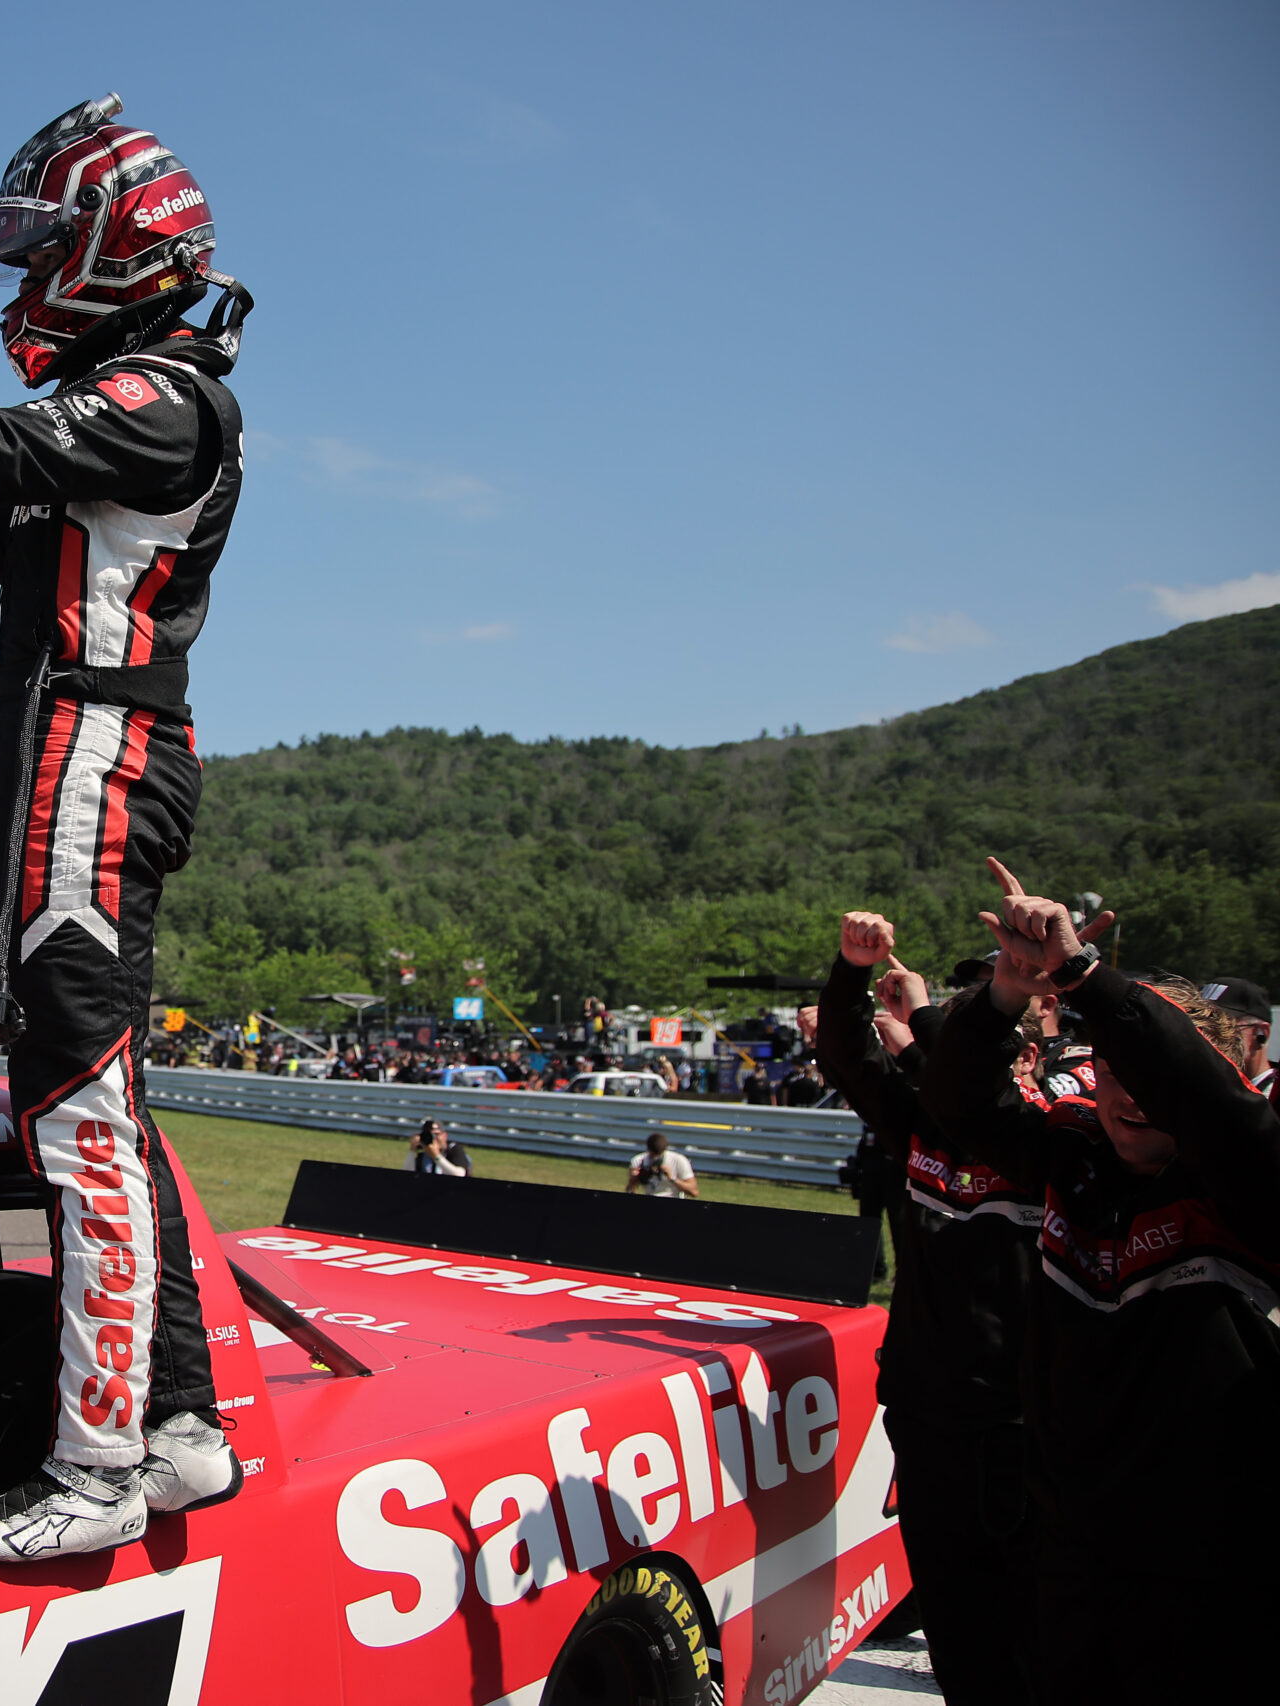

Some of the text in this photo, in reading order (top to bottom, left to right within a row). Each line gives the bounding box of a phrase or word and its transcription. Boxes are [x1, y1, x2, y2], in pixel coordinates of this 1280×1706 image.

[133, 187, 206, 229] Safelite
[456, 1000, 481, 1018] 44
[655, 1021, 680, 1043] 19
[1124, 1221, 1184, 1259] AGE
[75, 1119, 134, 1429] Safelite
[237, 1236, 799, 1328] Safelite
[206, 1325, 239, 1343] ELSIUS
[216, 1395, 255, 1411] Auto Group
[336, 1351, 839, 1648] Safelite
[764, 1563, 889, 1706] SiriusXM
